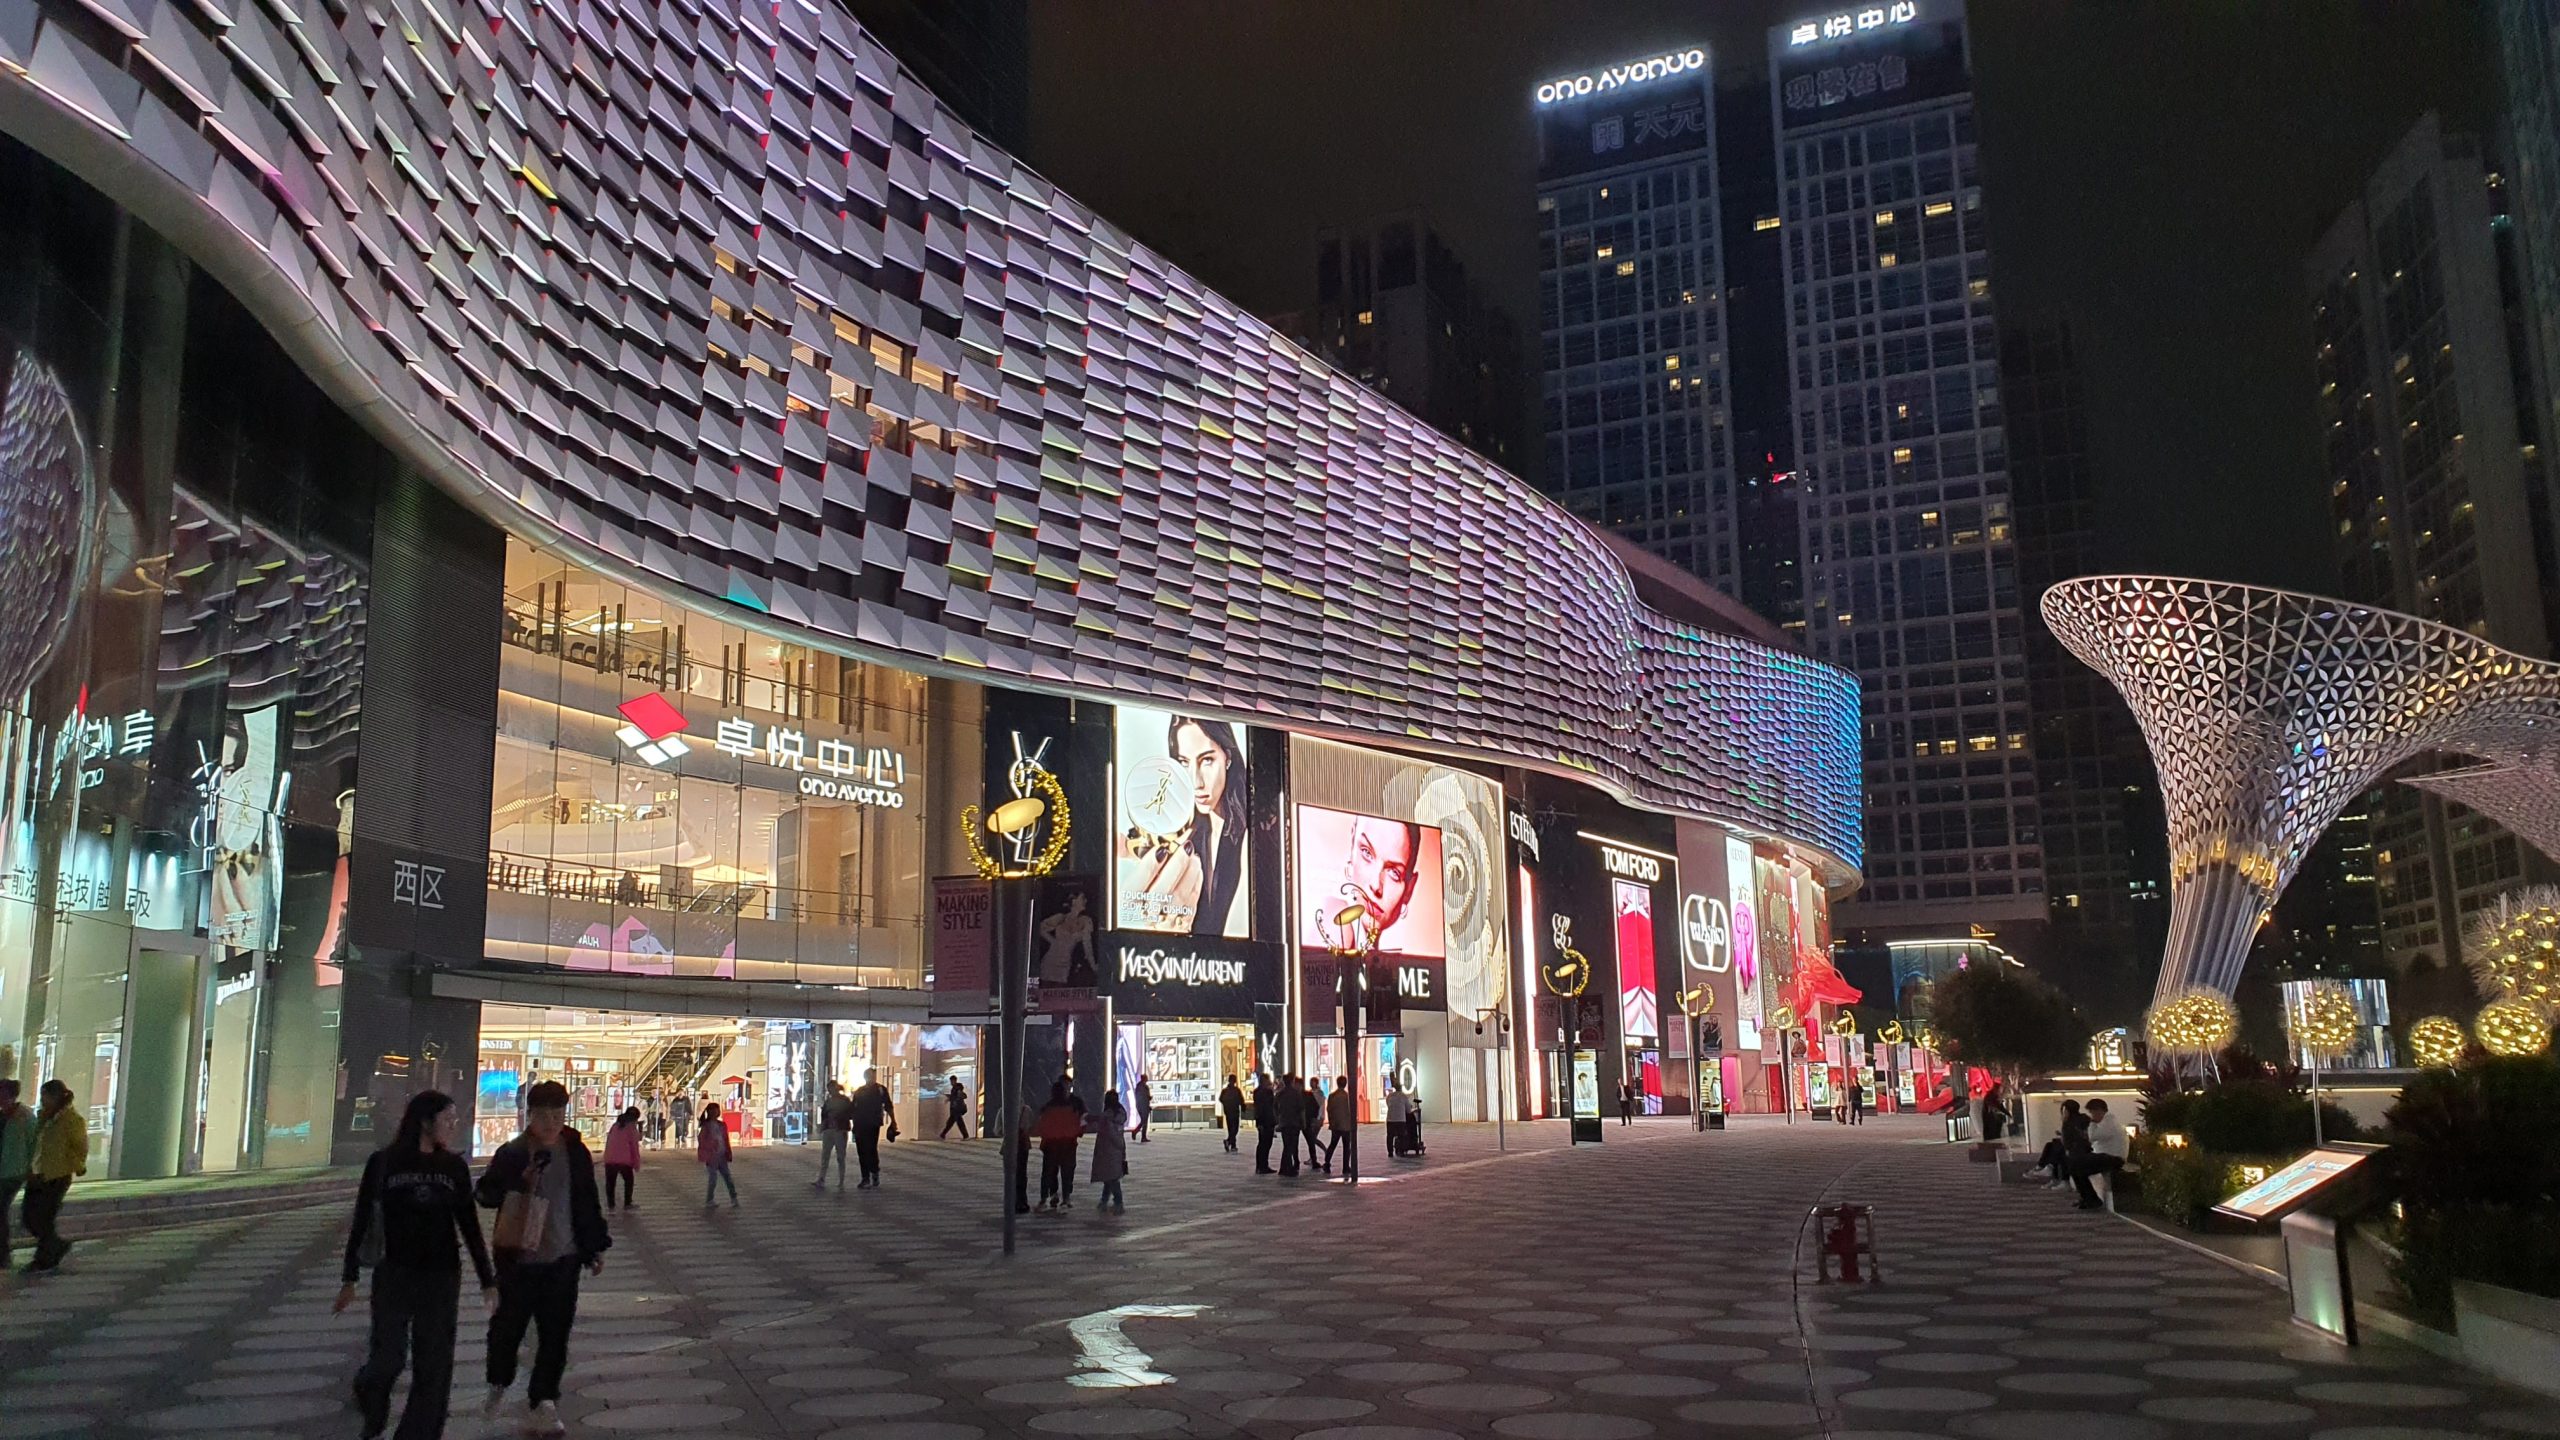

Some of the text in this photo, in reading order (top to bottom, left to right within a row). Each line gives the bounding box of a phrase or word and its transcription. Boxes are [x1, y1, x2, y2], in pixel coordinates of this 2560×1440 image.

[1790, 0, 1916, 46] 卓悦中心
[714, 715, 904, 789] 卓悦中心
[1601, 846, 1660, 882] TOM FORD
[394, 859, 447, 910] 西区
[937, 894, 989, 913] MAKING
[943, 912, 983, 931] STYLE
[1162, 904, 1193, 916] CUSHION
